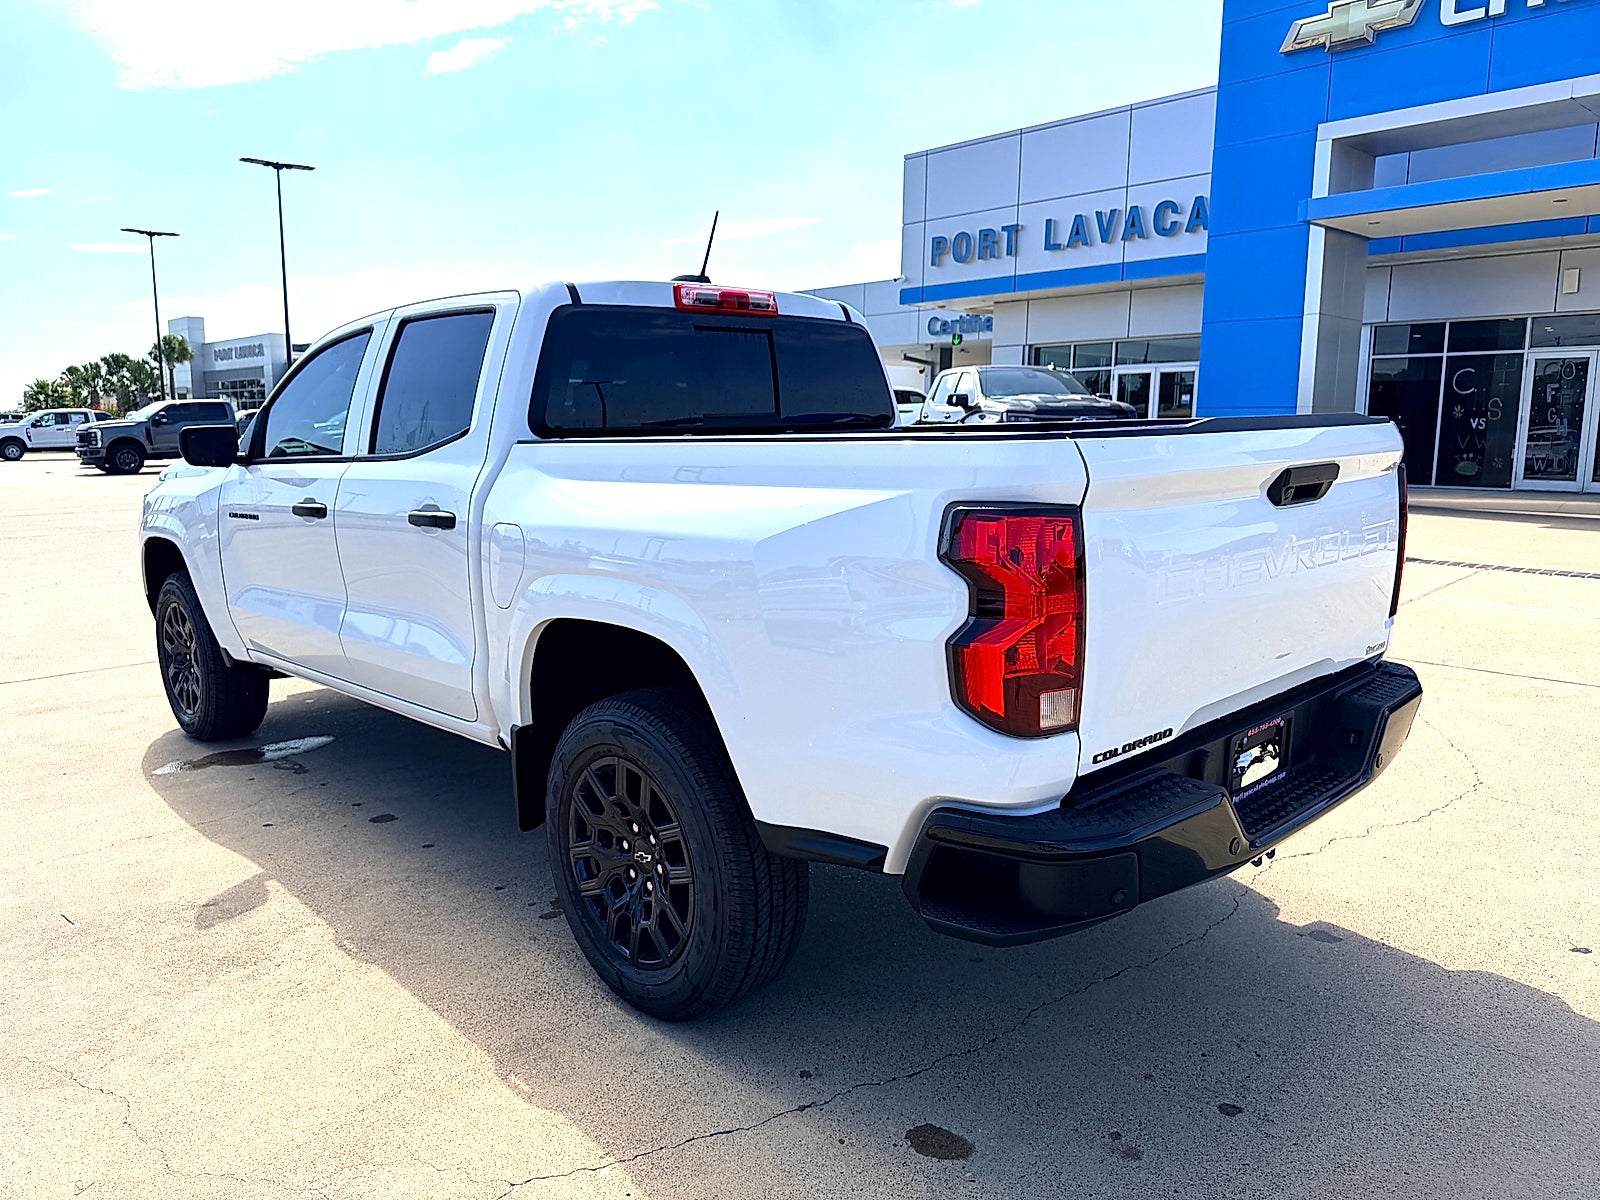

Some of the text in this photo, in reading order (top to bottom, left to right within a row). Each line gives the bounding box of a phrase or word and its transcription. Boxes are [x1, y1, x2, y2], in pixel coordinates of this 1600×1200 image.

[930, 196, 1208, 267] PORT LAVACA
[1155, 519, 1396, 604] CHEVROLET
[1092, 728, 1173, 764] COLORADO
